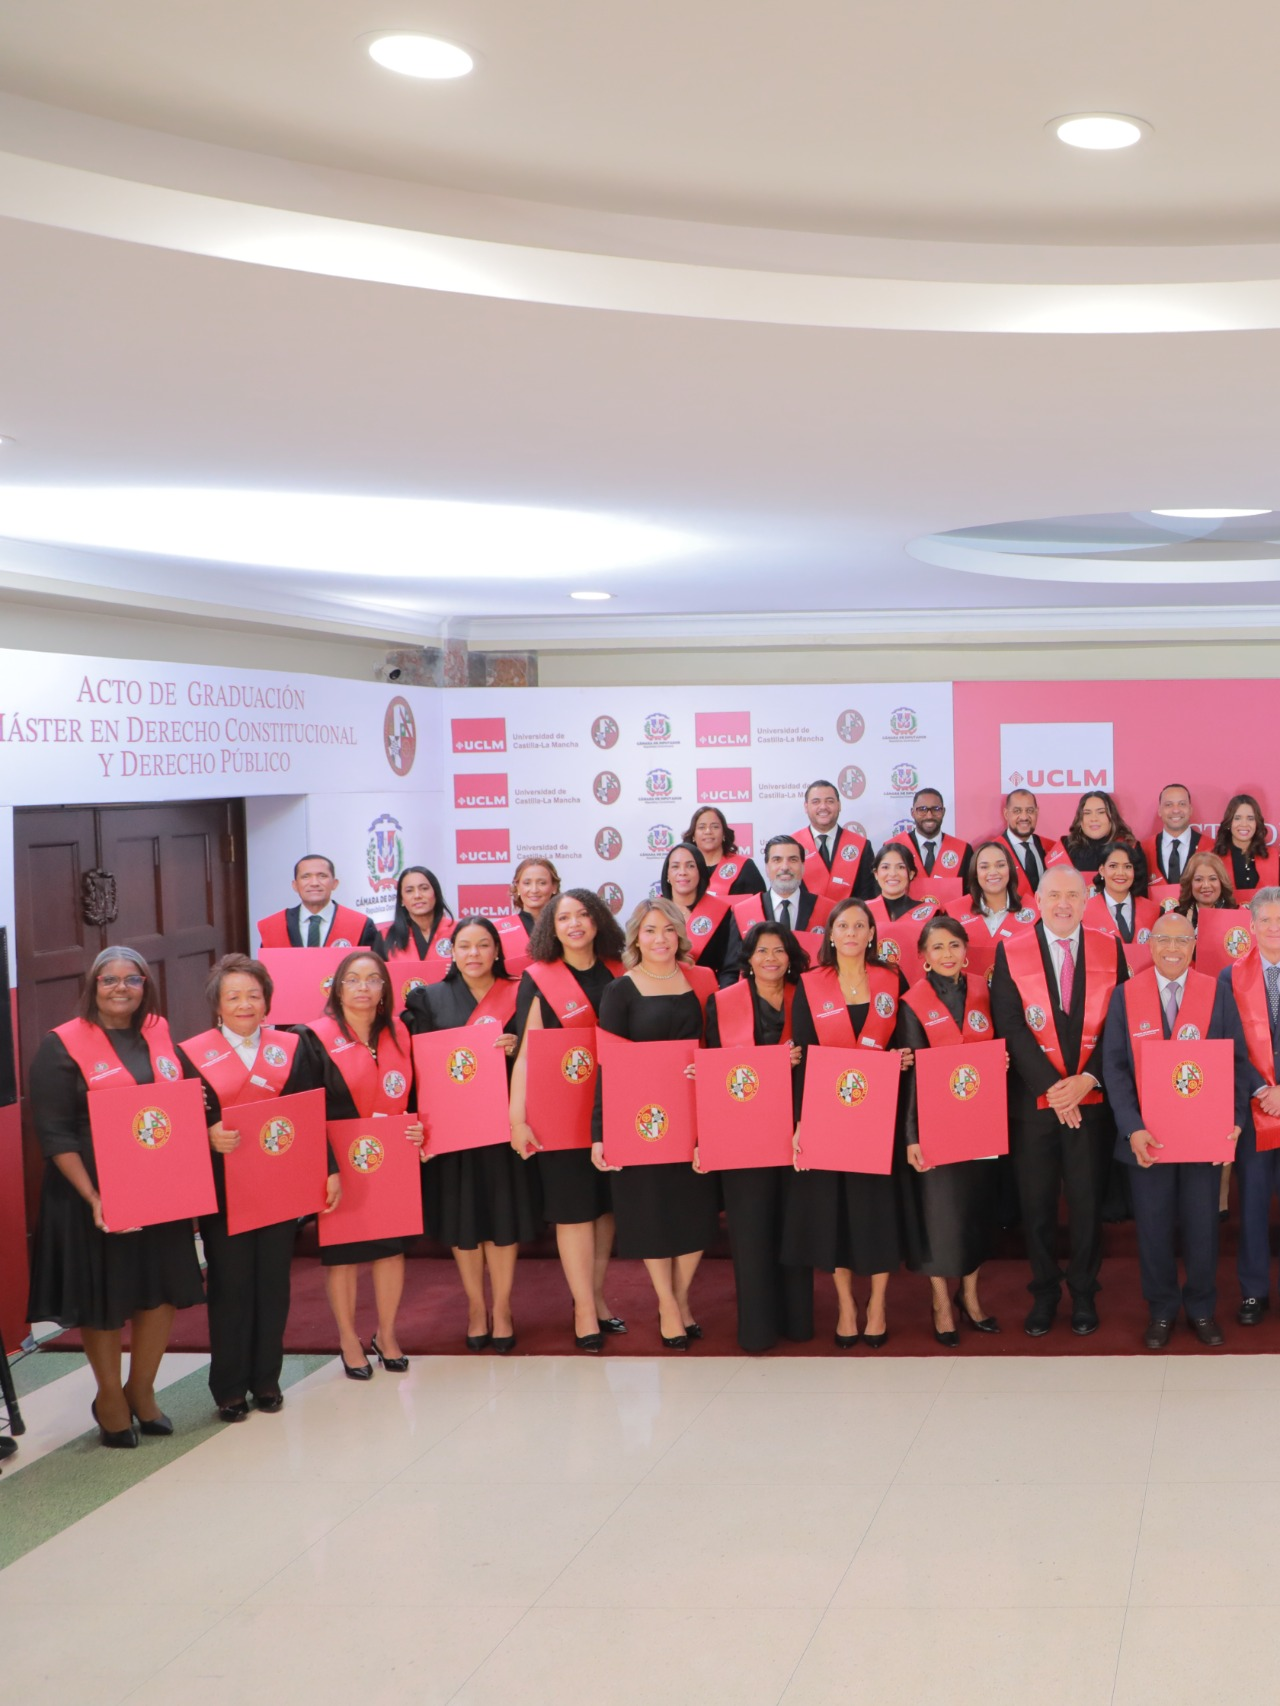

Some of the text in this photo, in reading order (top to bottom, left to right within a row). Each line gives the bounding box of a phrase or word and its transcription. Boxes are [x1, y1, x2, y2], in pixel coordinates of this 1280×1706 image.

[76, 675, 305, 710] ACTO DE GRADUACIÓN
[90, 720, 119, 742] EN
[127, 716, 220, 742] DERECHO
[225, 718, 357, 745] CONSTITUCIONAL
[708, 735, 748, 744] UCLM
[464, 740, 504, 750] UCLM
[98, 748, 291, 777] Y DERECHO PÚBLICO
[1027, 769, 1107, 787] UCLM
[709, 790, 749, 800] UCLM
[466, 796, 506, 806] UCLM
[468, 851, 508, 861] UCLM
[380, 894, 388, 903] DE
[470, 906, 510, 916] UCLM
